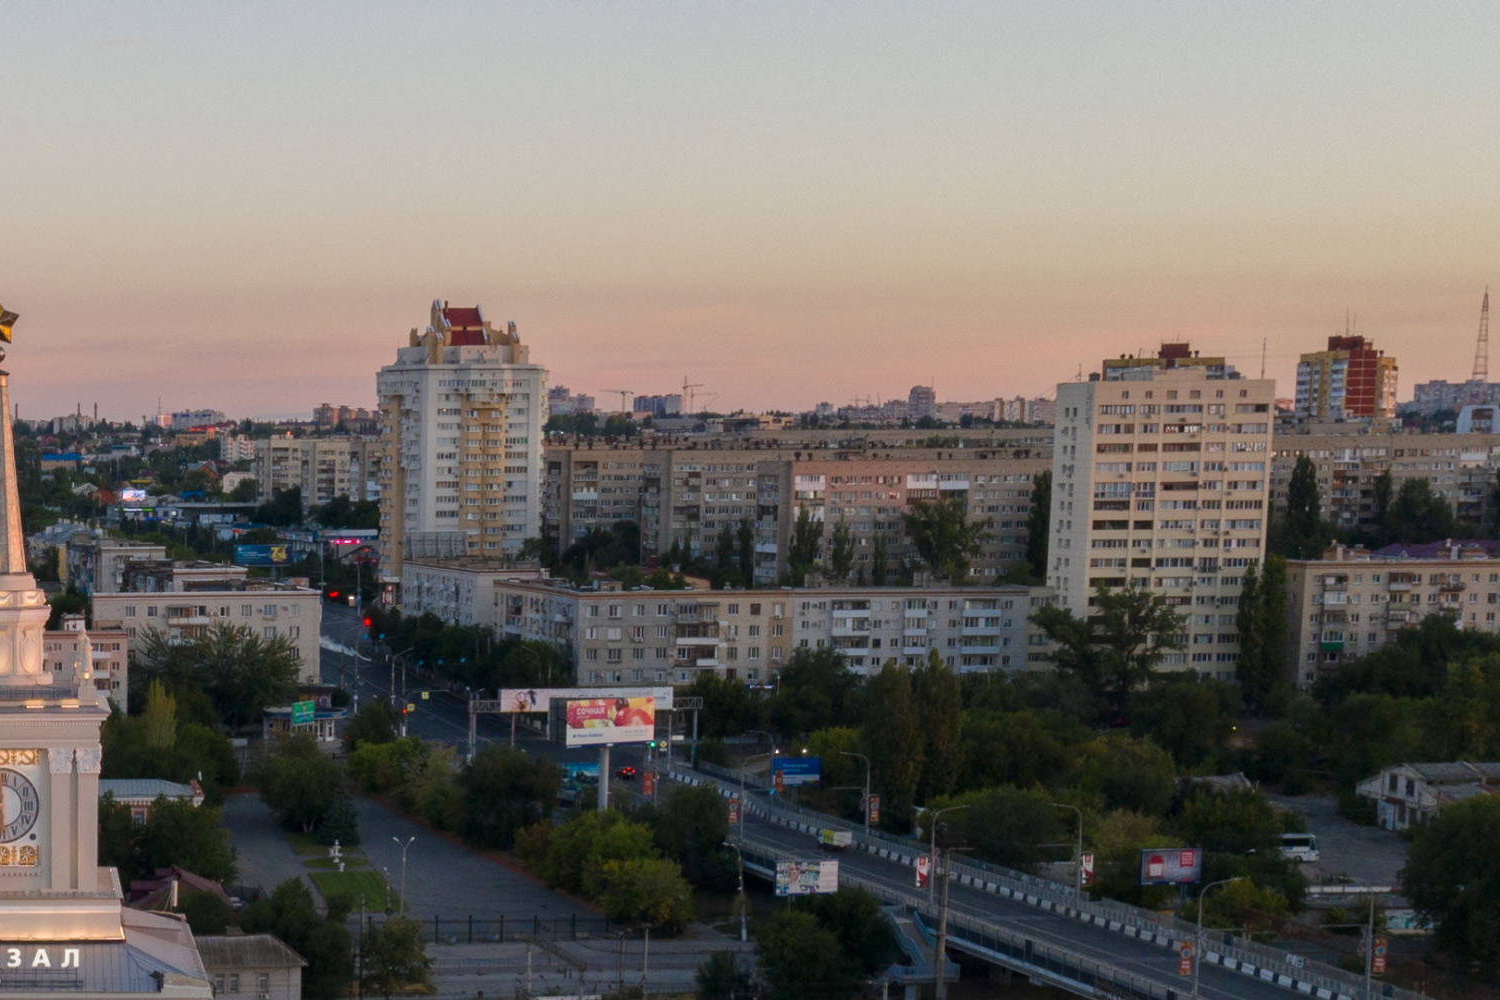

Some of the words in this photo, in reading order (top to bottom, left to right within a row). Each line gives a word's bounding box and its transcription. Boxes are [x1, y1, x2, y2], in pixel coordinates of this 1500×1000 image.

[576, 706, 606, 717] СОЧНАЯ
[22, 786, 29, 797] II
[24, 801, 34, 811] III
[21, 815, 32, 825] IV
[11, 825, 18, 836] V
